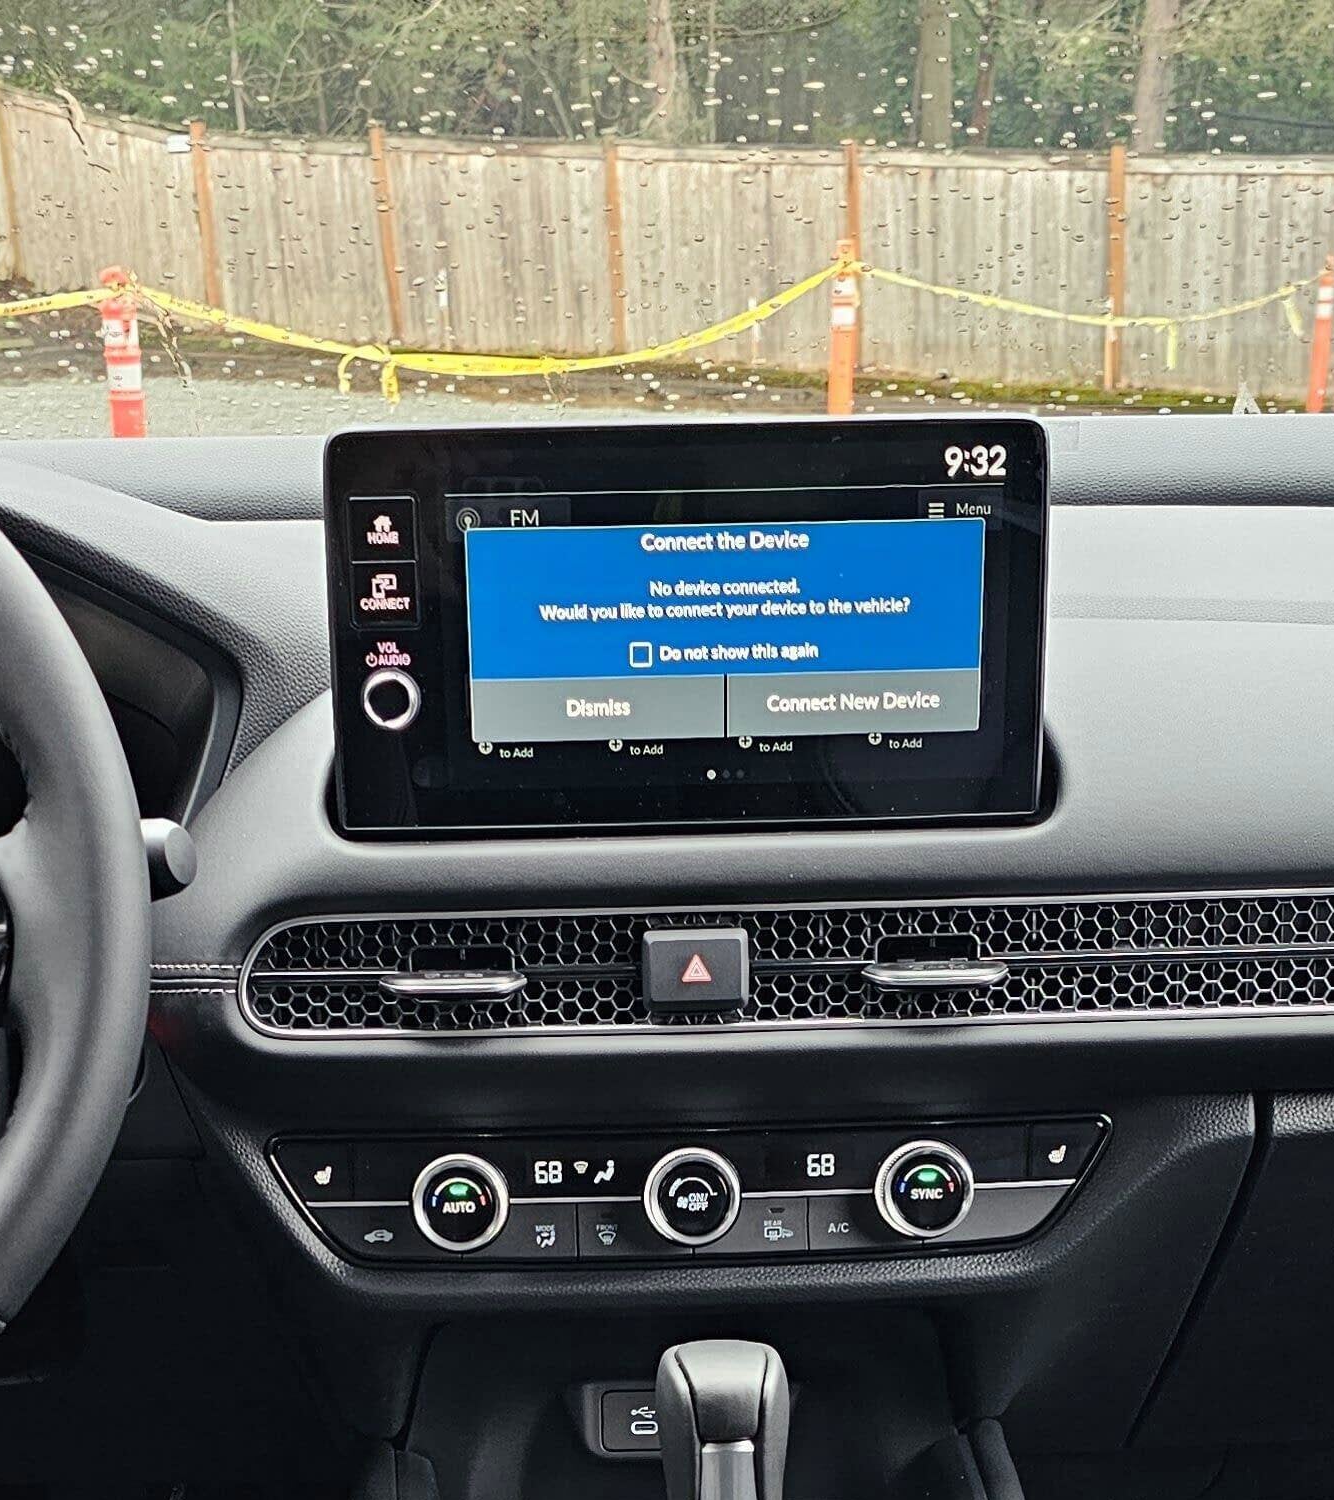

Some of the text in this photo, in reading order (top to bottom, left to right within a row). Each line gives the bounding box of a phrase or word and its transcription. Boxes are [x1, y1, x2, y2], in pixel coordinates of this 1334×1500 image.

[944, 444, 1007, 477] 9:32
[956, 503, 992, 516] Menu
[510, 509, 540, 527] FM
[367, 532, 400, 545] HOME
[640, 530, 810, 551] Connect the Device
[649, 577, 801, 597] No device connected.
[360, 597, 411, 611] CONNECT
[539, 596, 912, 622] Would you like to connect your device to the vehicle?
[377, 641, 400, 654] VOL
[659, 642, 819, 662] Do not show this again
[378, 653, 411, 666] AUDIO
[566, 698, 632, 718] Dismiss
[766, 690, 941, 713] Connect New Device
[629, 744, 664, 756] to Add
[759, 741, 793, 754] to Add
[889, 737, 923, 750] to Add
[499, 747, 534, 759] to Add
[806, 1153, 835, 1177] 68
[534, 1160, 563, 1184] 68
[910, 1187, 944, 1200] SYNC
[442, 1201, 476, 1214] AUTO
[535, 1223, 555, 1232] MODE
[596, 1223, 617, 1231] FRONT
[827, 1221, 850, 1234] A/C
